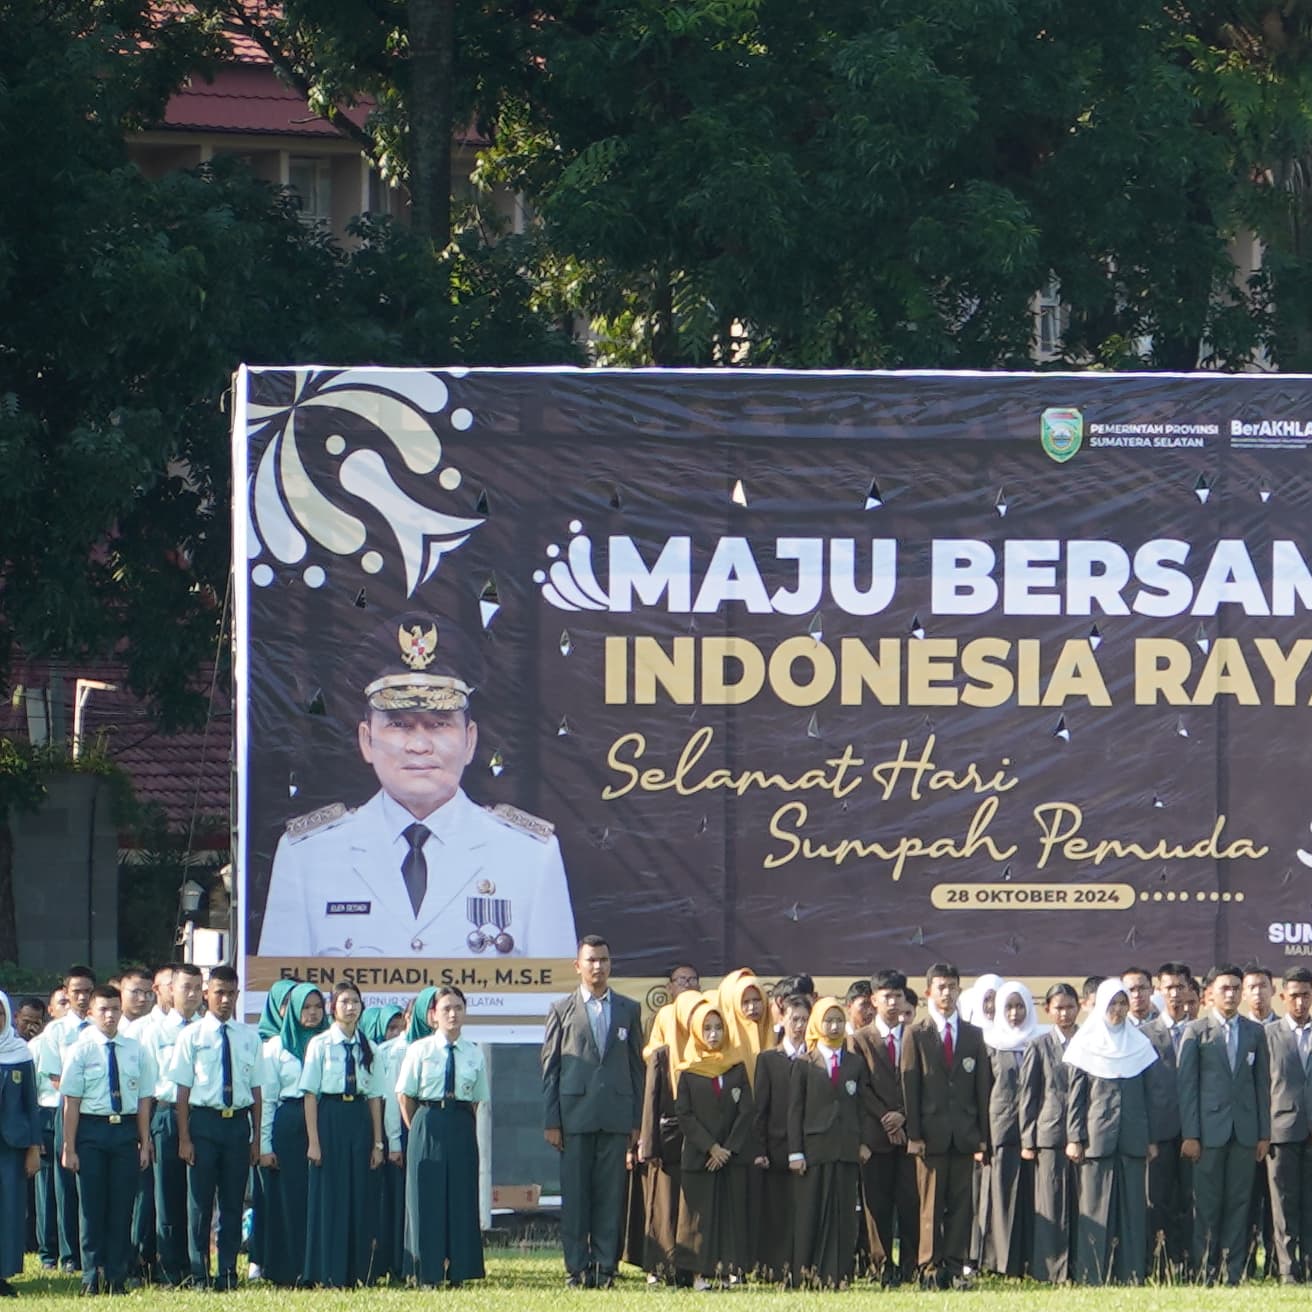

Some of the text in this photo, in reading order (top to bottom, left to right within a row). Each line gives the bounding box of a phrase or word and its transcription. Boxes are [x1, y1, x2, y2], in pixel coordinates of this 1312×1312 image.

[1089, 437, 1204, 448] SUMATERA SELATAN
[1090, 424, 1219, 434] PEMERINTAH PROVINSI
[609, 535, 897, 616] MAJU
[605, 636, 1112, 707] INDONESIA
[601, 726, 1019, 801] Selamat Hari
[763, 796, 1269, 881] Sumpah Pemuda
[946, 890, 1120, 903] 28 OKTOBER 2024
[343, 968, 434, 985] SETIADI,
[441, 968, 488, 988] S.H.,
[496, 969, 553, 985] M.S.E
